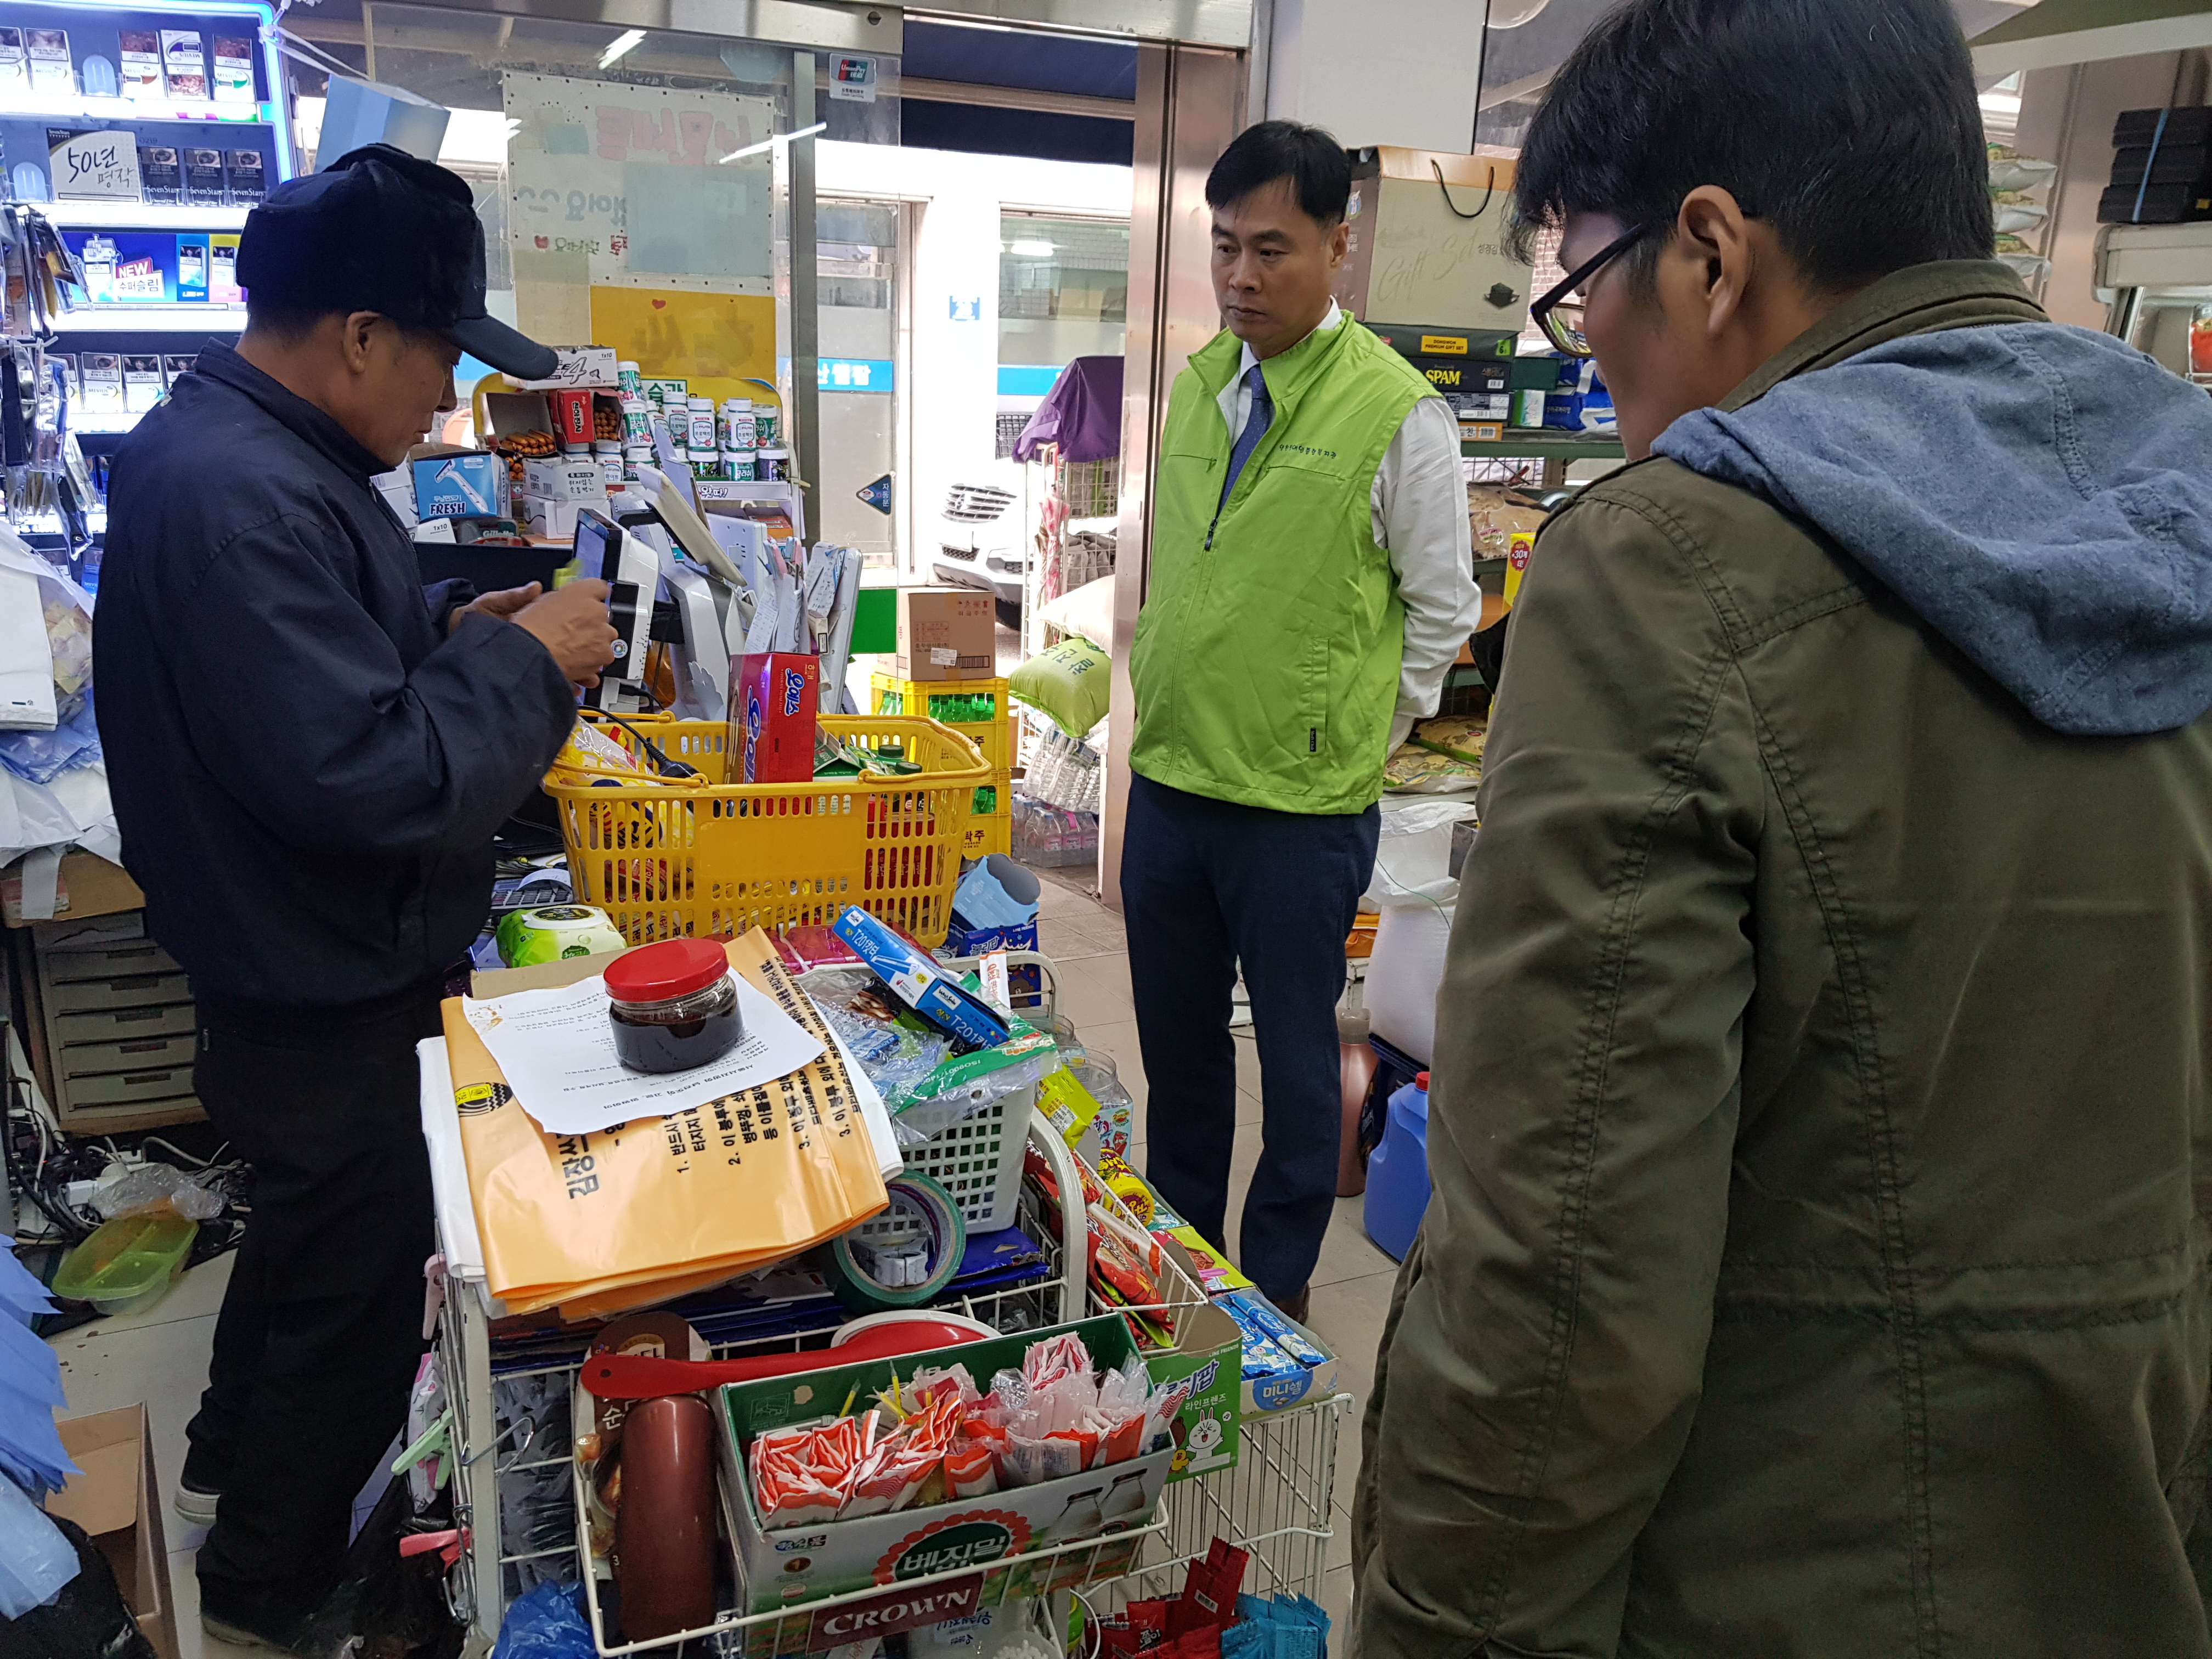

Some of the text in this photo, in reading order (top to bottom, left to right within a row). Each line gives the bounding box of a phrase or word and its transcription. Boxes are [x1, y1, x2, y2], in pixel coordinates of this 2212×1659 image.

[68, 145, 119, 183] 50년
[98, 167, 134, 188] 명작
[119, 261, 149, 278] NEW
[120, 278, 159, 292] 수퍼슬림
[1426, 370, 1462, 386] SPAM
[700, 486, 729, 498] 왓따!
[430, 501, 467, 516] FRESH
[785, 668, 804, 716] 오예스
[825, 1085, 844, 1108] 봉투
[785, 1096, 803, 1119] 봉투
[832, 1109, 846, 1122] 이
[686, 1118, 706, 1152] 터지지
[763, 1128, 778, 1140] 등
[792, 1119, 805, 1133] 이
[664, 1122, 686, 1156] 반드시
[721, 1135, 736, 1147] 이
[556, 1133, 600, 1200] 김장쓰
[1224, 1344, 1240, 1354] FRIENDS
[1263, 1380, 1302, 1398] 미니쉘
[1185, 1393, 1227, 1411] 라인프렌즈
[904, 1534, 1008, 1572] 베지밀
[823, 1589, 972, 1635] CROWN
